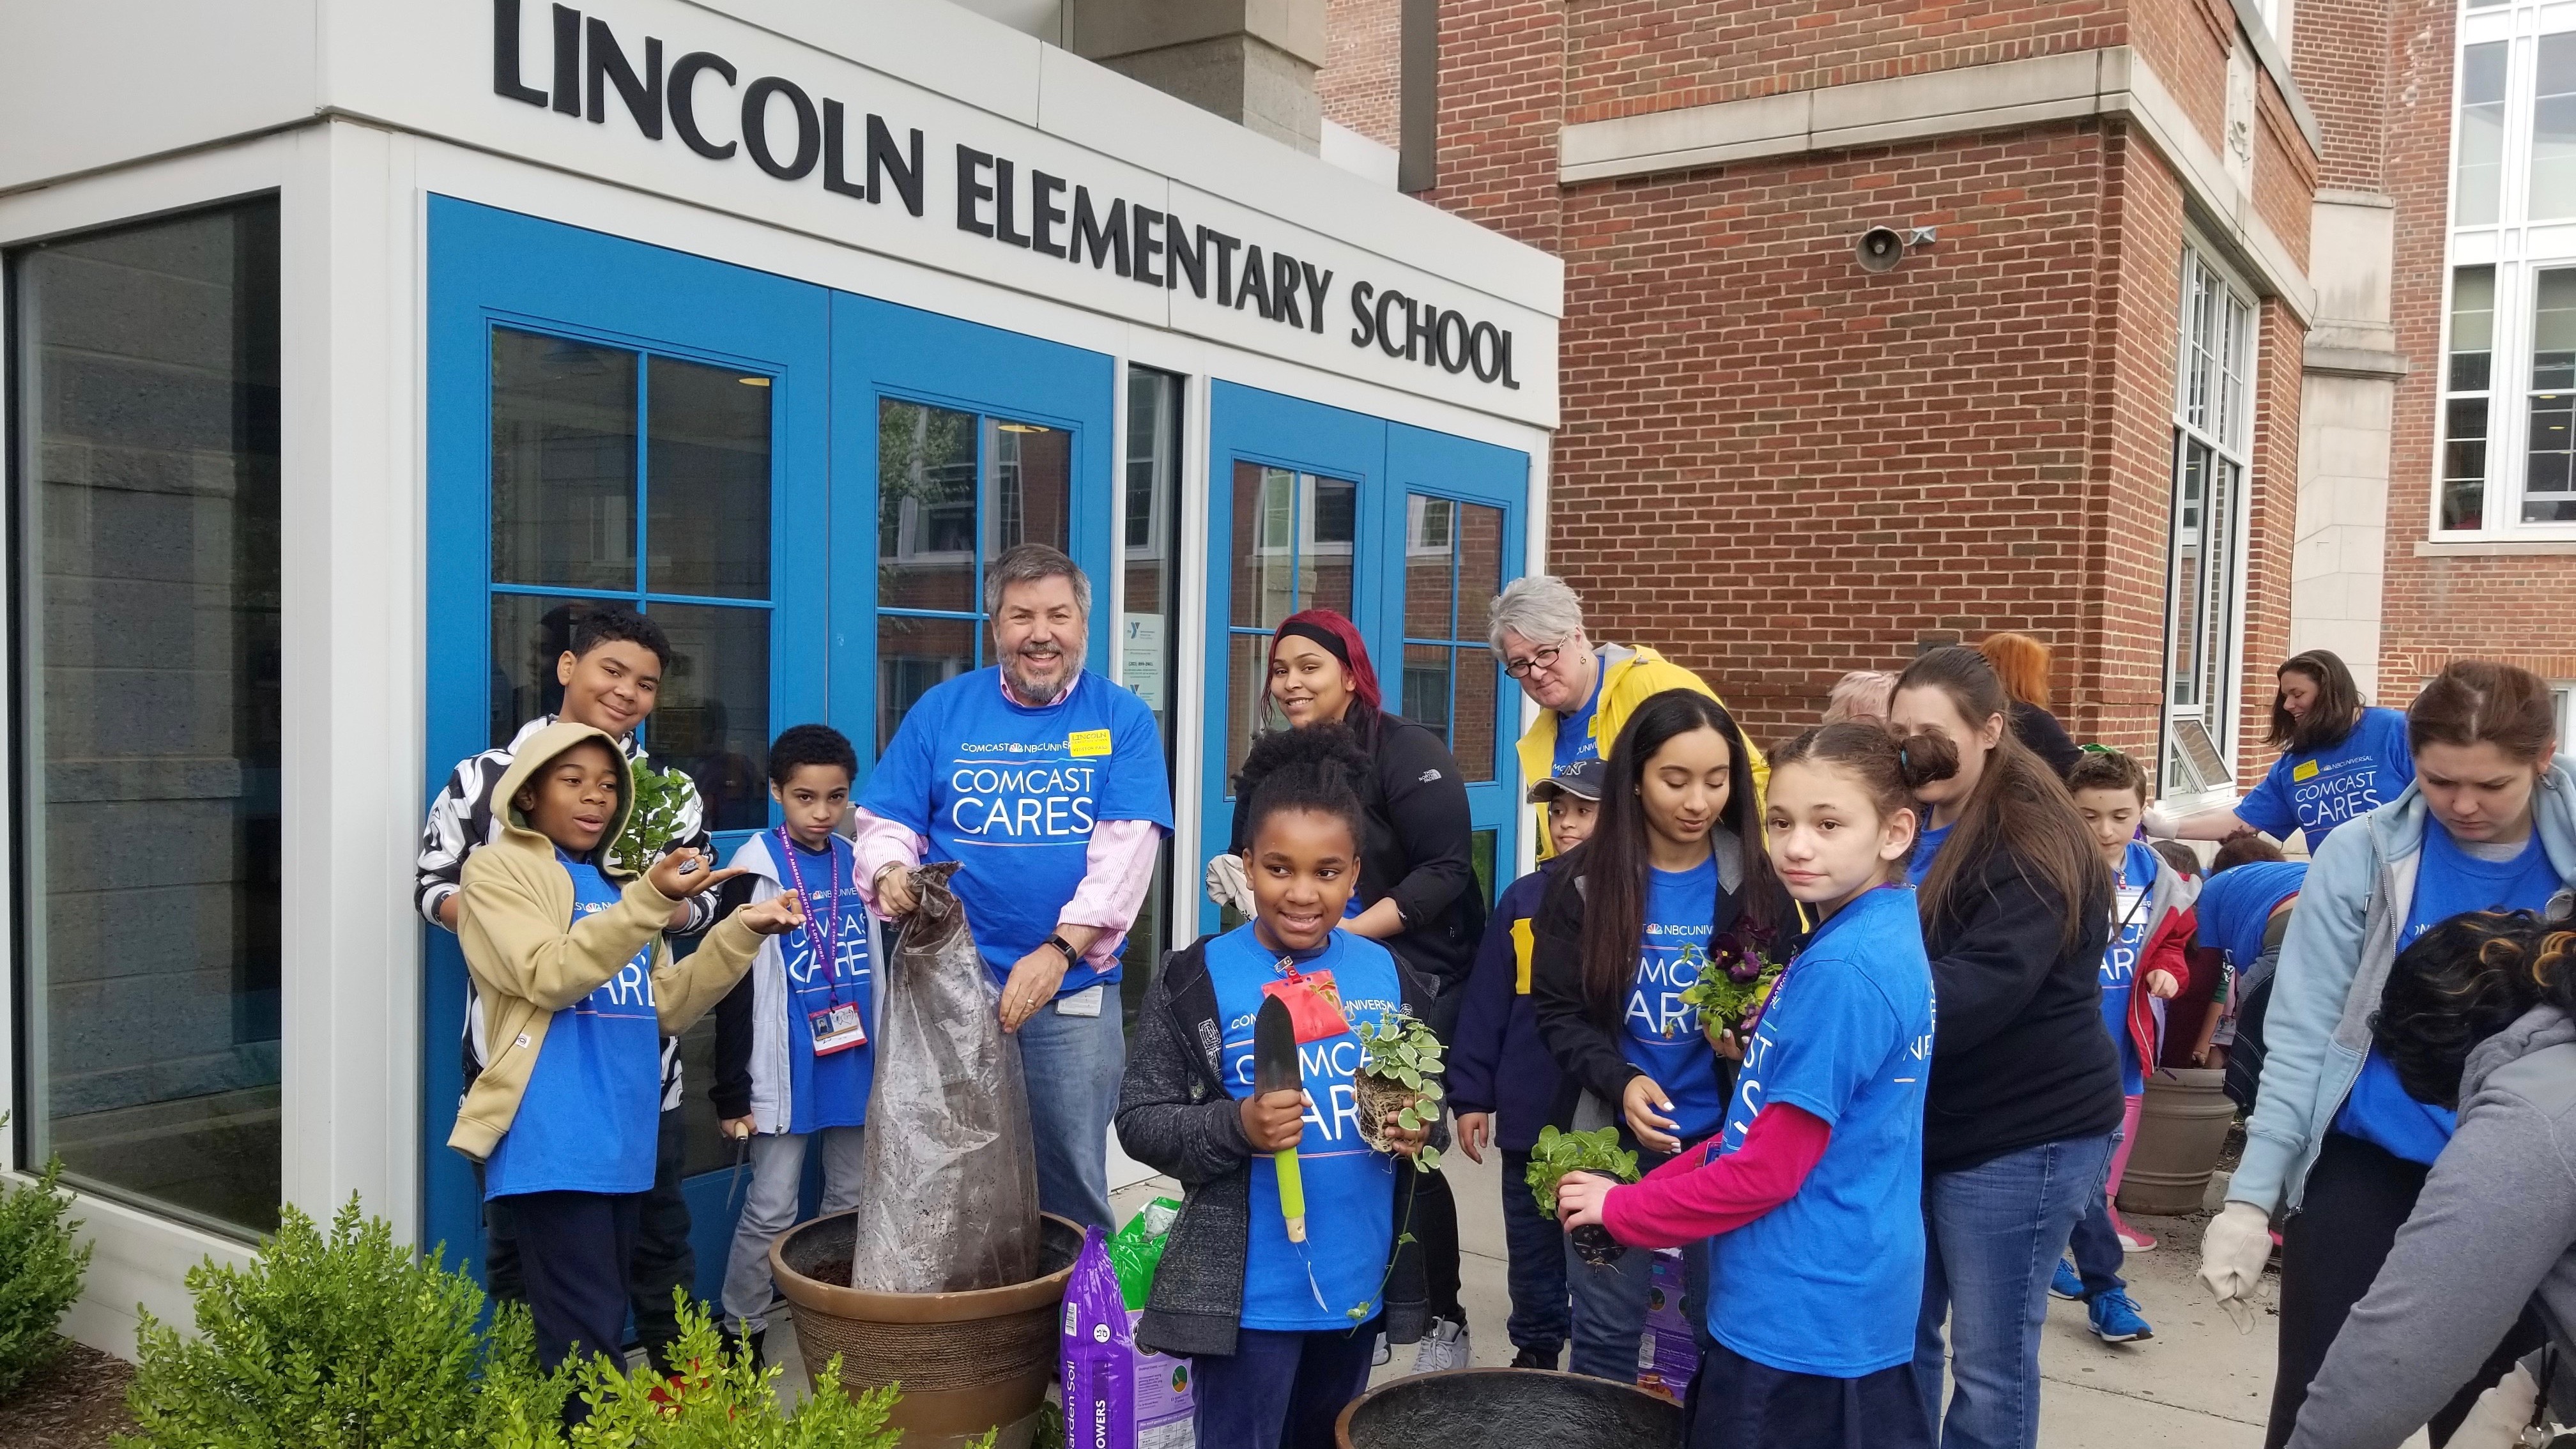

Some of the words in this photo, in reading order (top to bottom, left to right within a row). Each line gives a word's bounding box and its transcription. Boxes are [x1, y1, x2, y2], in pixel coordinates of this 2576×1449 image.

[494, 0, 923, 217] LINCOLN
[956, 143, 1333, 334] ELEMENTARY
[1351, 280, 1520, 390] SCHOOL
[961, 742, 1009, 753] COMCAST
[1073, 732, 1106, 740] LINCOLN
[953, 767, 1094, 793] COMCAST
[2295, 771, 2377, 802] COMCAST
[953, 797, 1094, 836] CARES
[2297, 789, 2382, 827] CARES
[811, 928, 820, 944] LOVE
[816, 941, 826, 961] WINS!
[1102, 1329, 1108, 1338] CF
[1066, 1360, 1075, 1393] Soil
